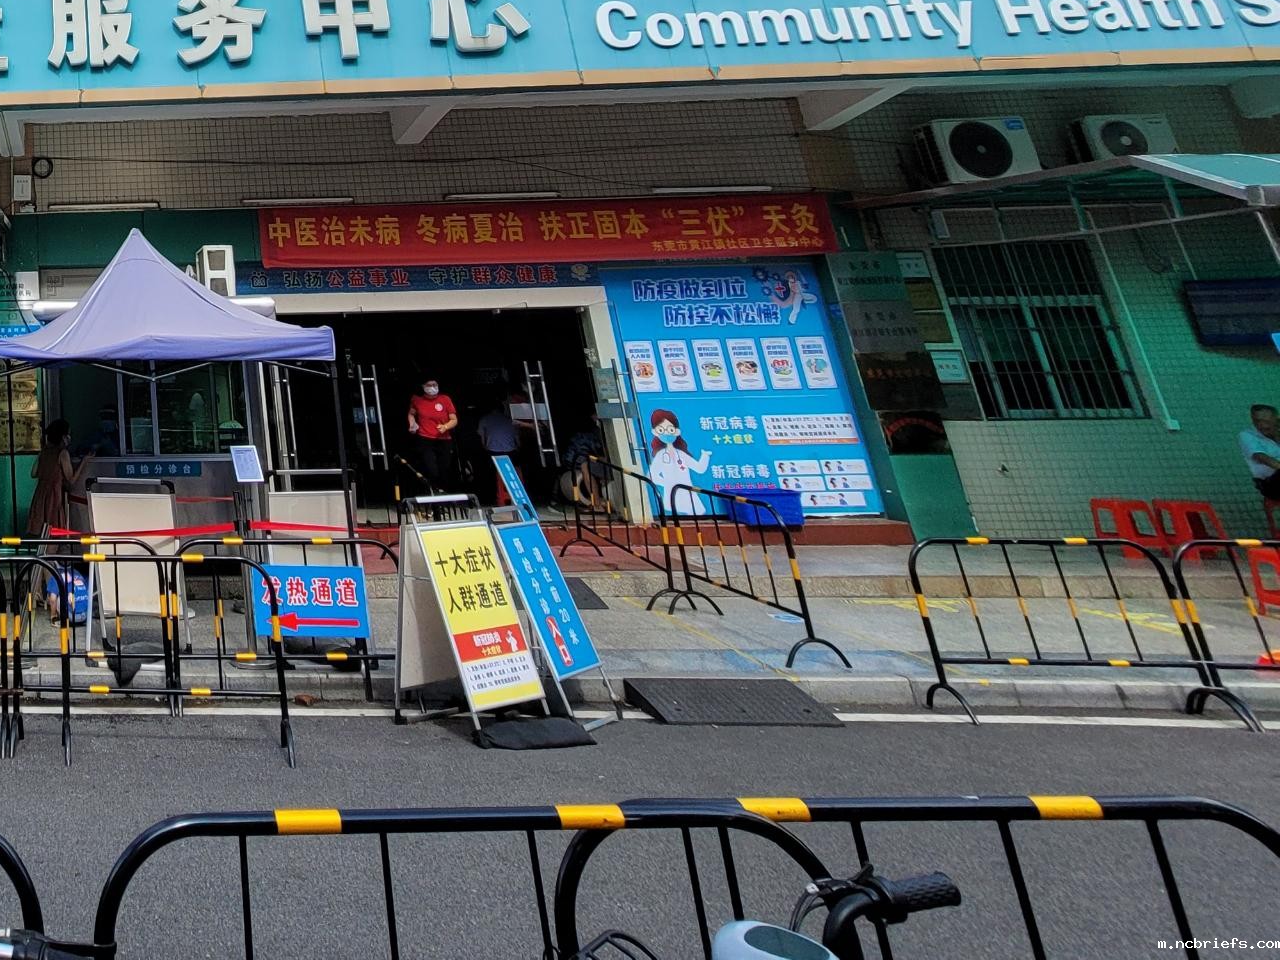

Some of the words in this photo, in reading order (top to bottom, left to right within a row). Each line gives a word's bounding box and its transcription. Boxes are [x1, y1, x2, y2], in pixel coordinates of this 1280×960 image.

[268, 213, 401, 248] 中医治未病
[416, 211, 524, 245] 冬病夏治
[539, 208, 649, 242] 扶正固本
[762, 201, 820, 236] 天灸
[284, 268, 410, 288] 弘扬公益事业
[428, 264, 558, 286] 守护群众健康
[632, 276, 748, 302] 防疫做到位
[663, 302, 781, 328] 防控不松懈
[699, 415, 758, 431] 新冠病毒
[712, 433, 754, 445] 十大症状
[125, 463, 191, 475] 预检分诊台
[710, 463, 771, 480] 新冠病毒
[434, 545, 496, 578] 十大症状
[261, 575, 359, 607] 发热通道
[447, 580, 508, 615] 人群通道
